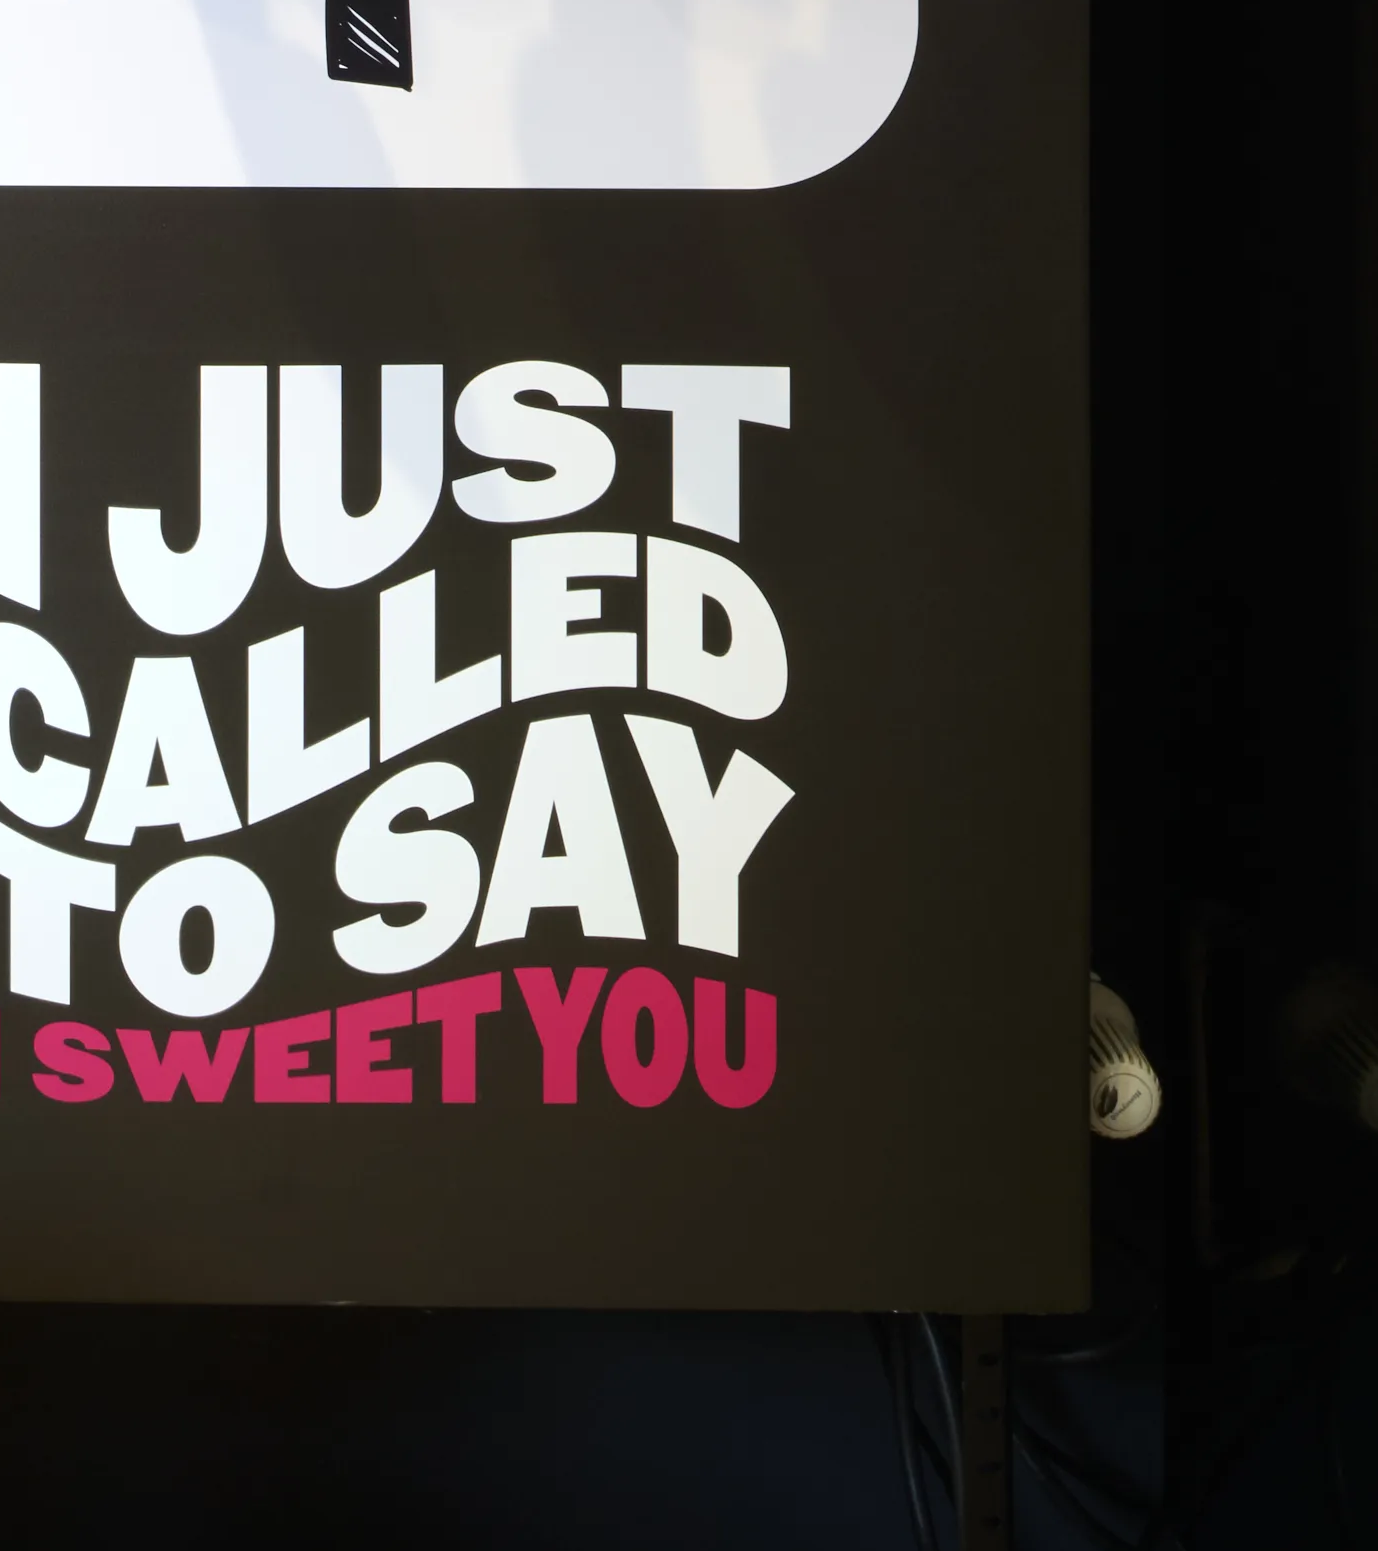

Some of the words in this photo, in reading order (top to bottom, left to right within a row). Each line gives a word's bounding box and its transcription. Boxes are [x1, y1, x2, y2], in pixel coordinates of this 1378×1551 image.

[108, 360, 791, 635] JUST
[332, 713, 796, 974] SAY
[31, 970, 503, 1104] SWEET
[512, 965, 778, 1108] YOU
